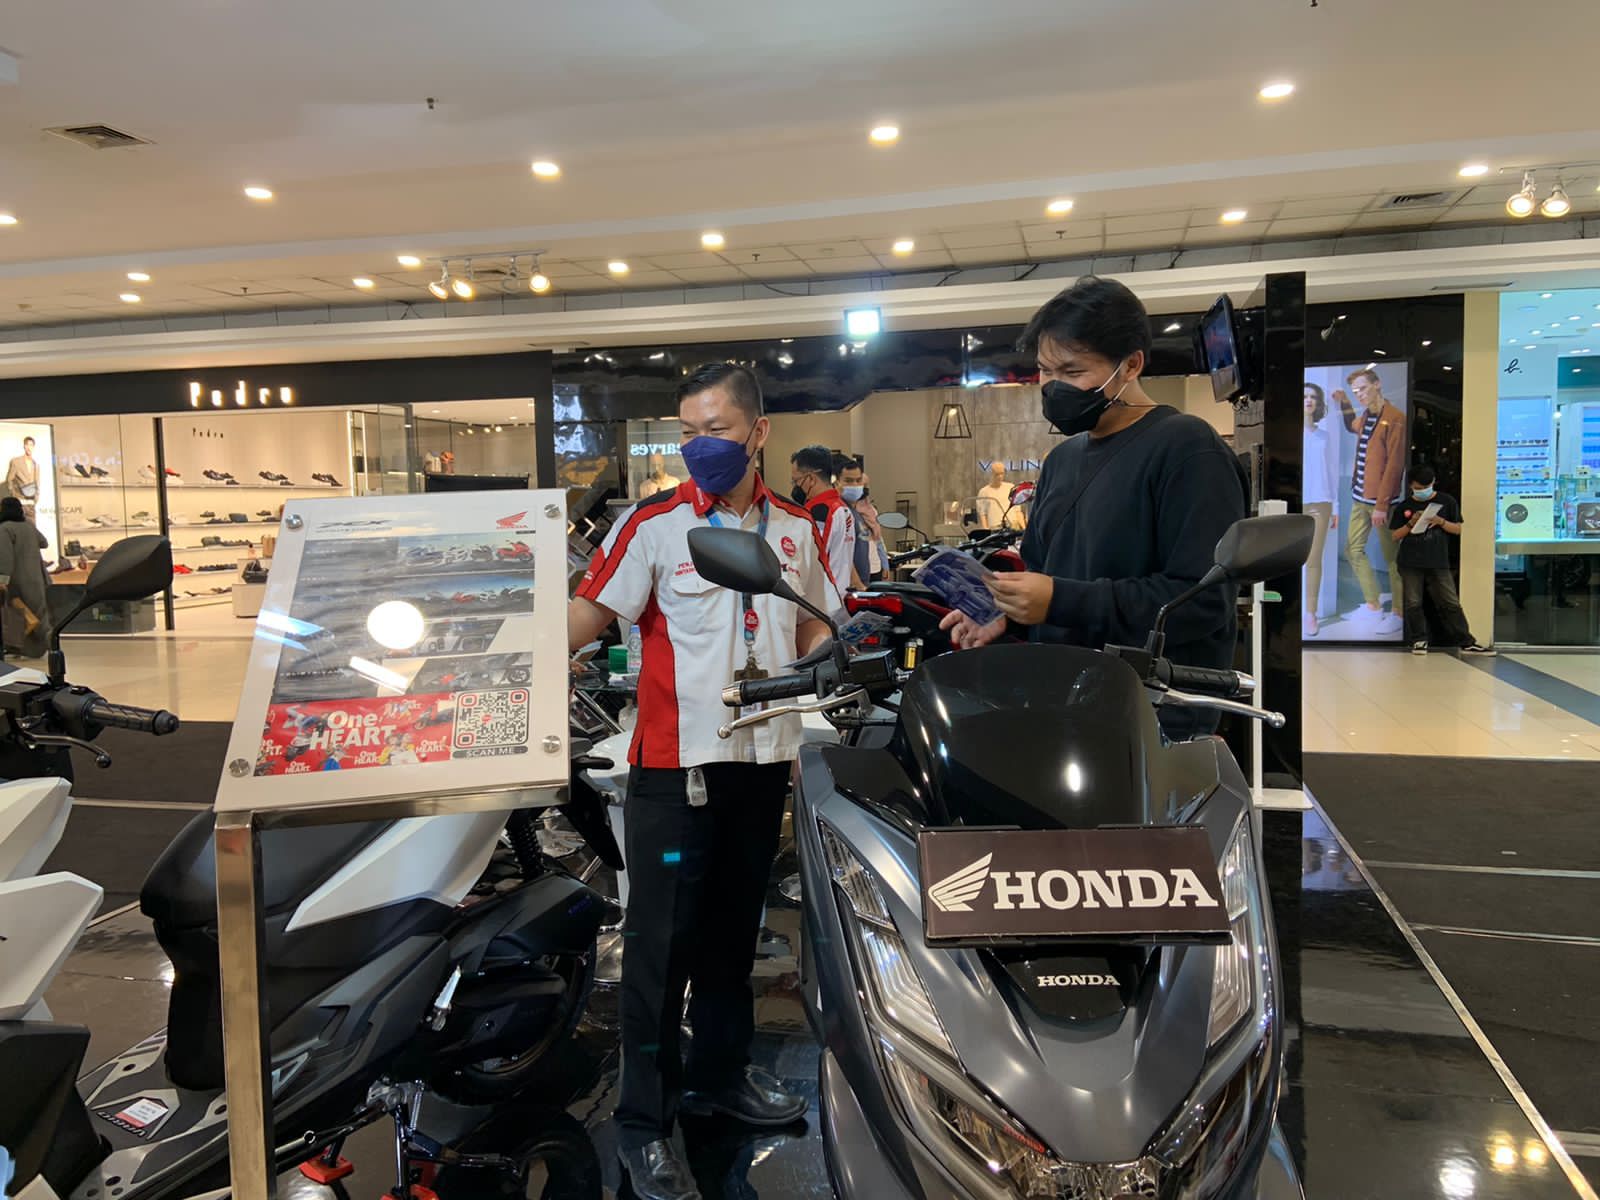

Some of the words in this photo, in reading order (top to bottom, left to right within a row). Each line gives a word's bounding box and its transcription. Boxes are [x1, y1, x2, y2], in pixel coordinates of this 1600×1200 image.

[189, 380, 293, 408] Pedro
[978, 459, 1041, 472] VLIN
[327, 711, 378, 729] One
[309, 725, 397, 751] HEART
[466, 748, 495, 758] SCAN
[498, 747, 515, 756] ME
[990, 868, 1218, 909] HONDA
[1037, 974, 1121, 988] HONDA
